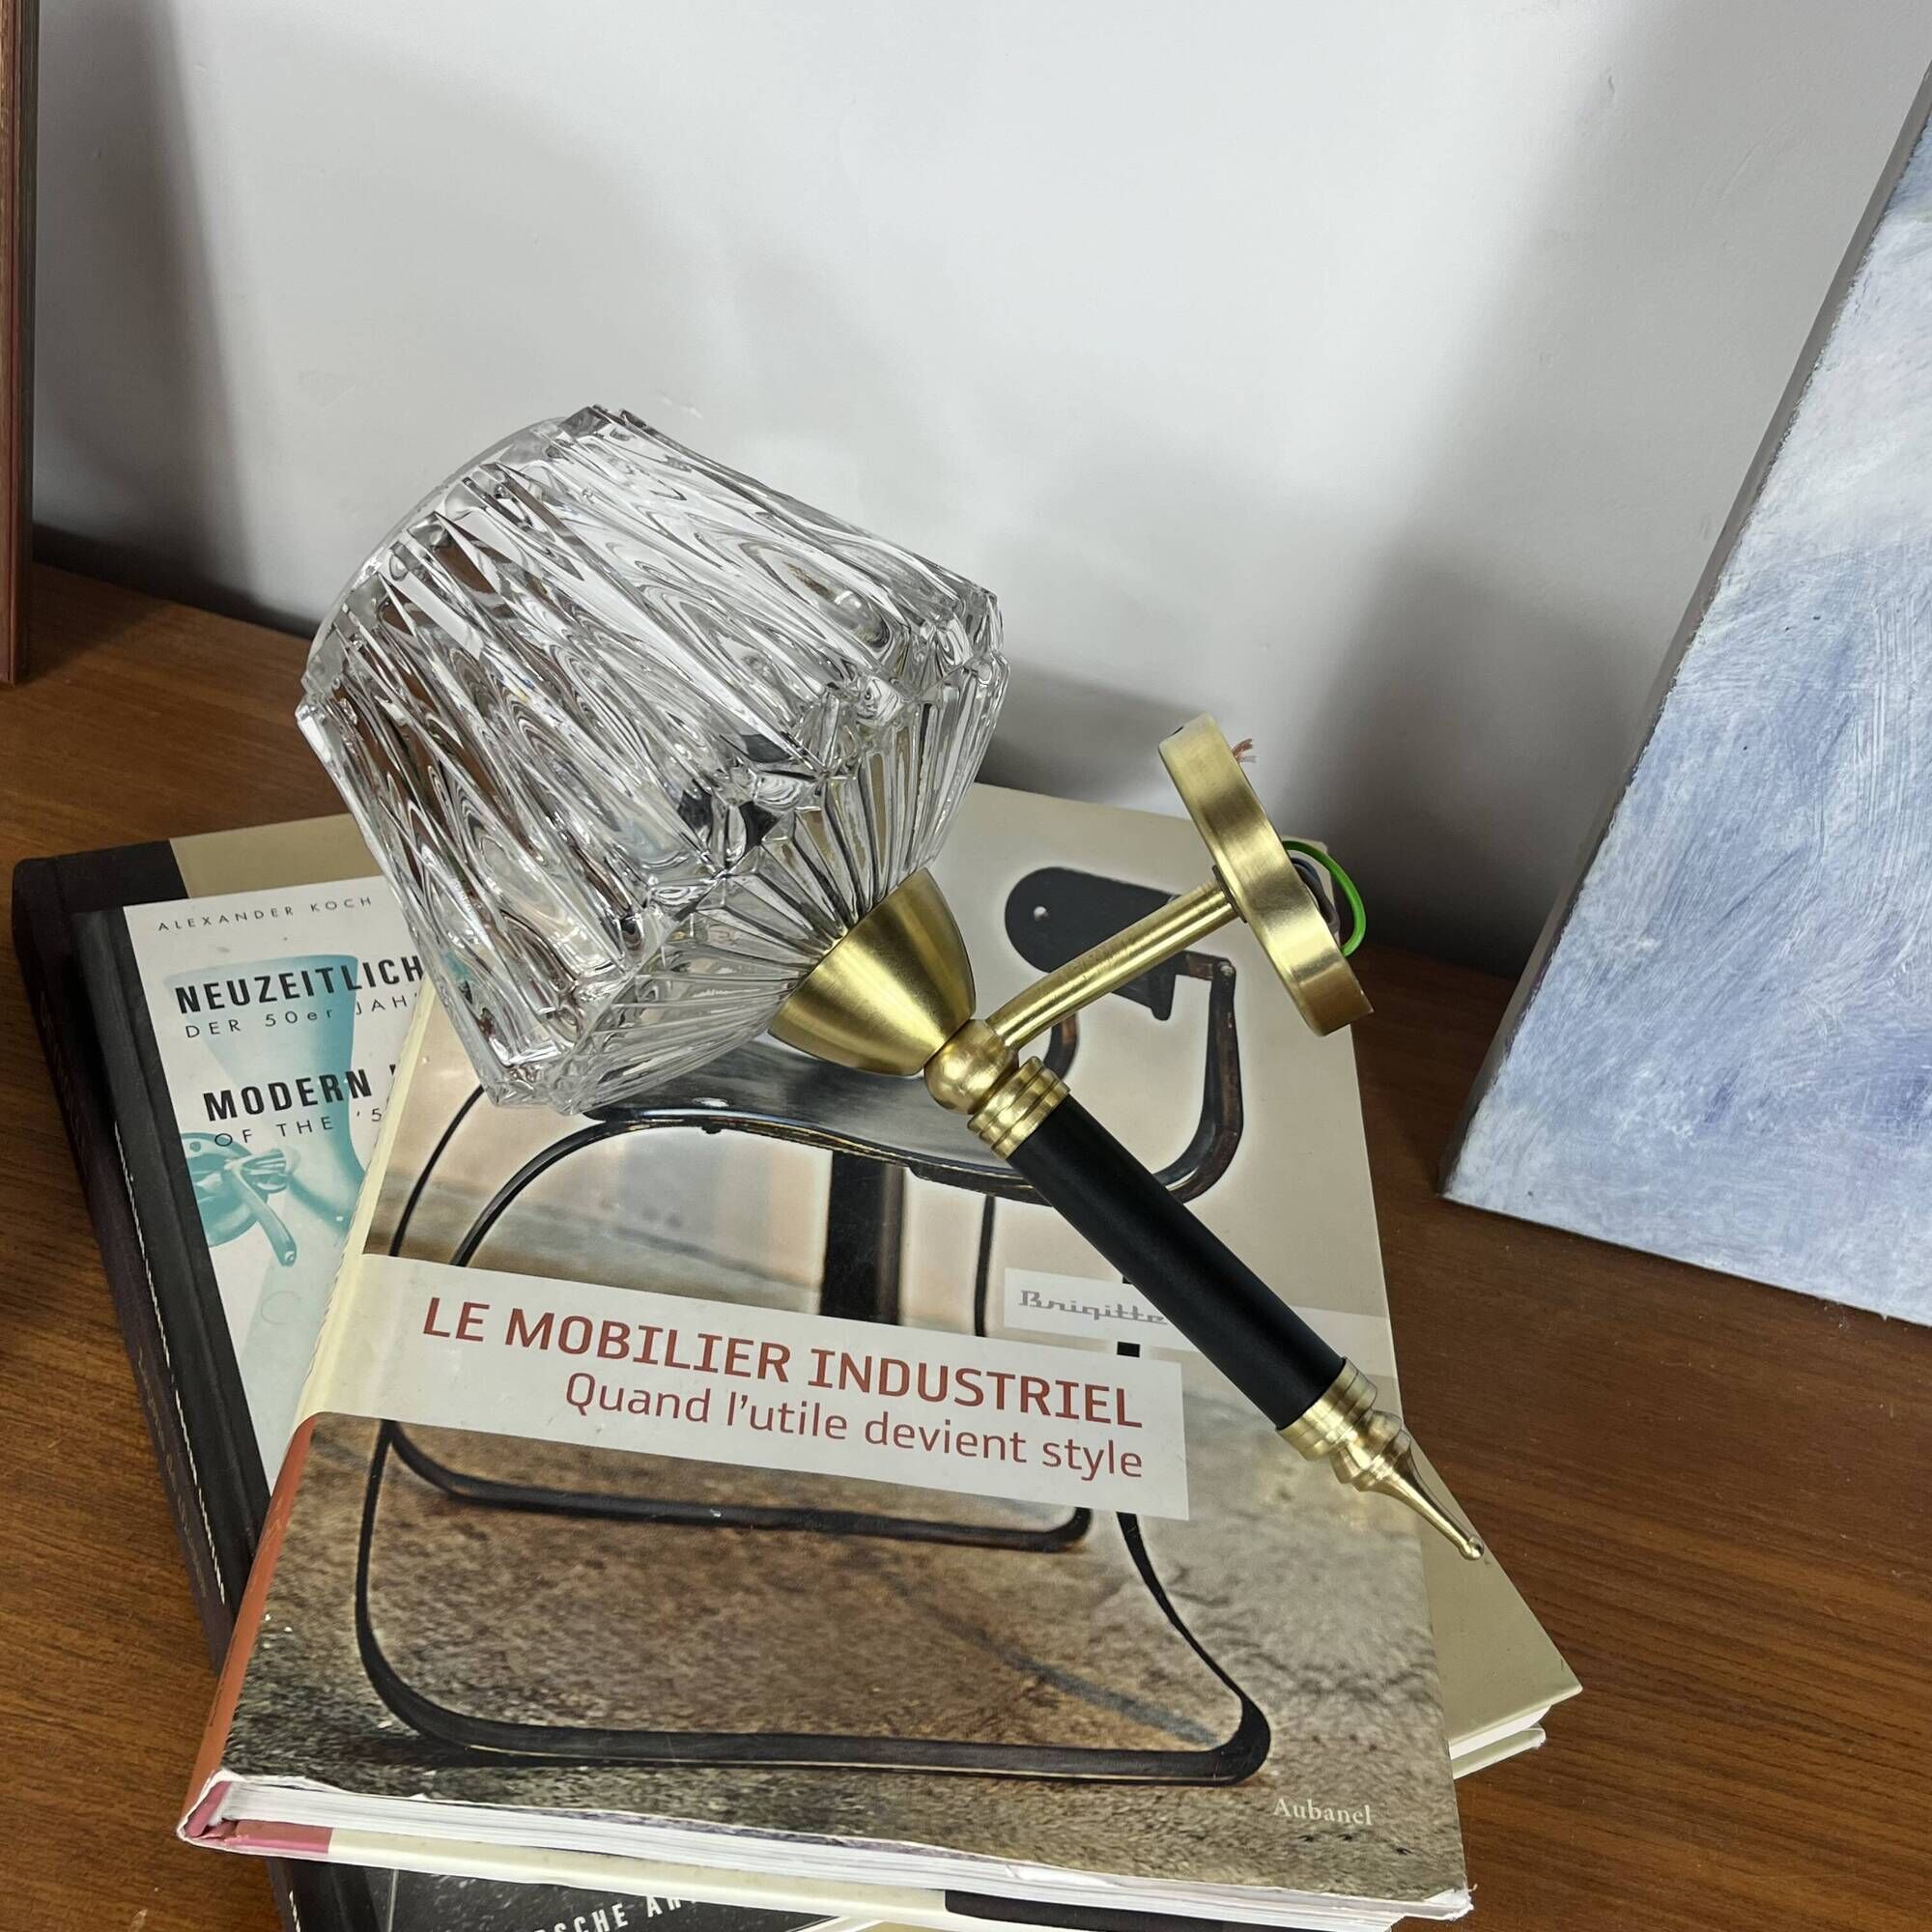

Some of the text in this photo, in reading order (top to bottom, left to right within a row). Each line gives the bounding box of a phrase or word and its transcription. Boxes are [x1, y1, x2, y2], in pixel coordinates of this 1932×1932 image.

[158, 895, 372, 931] ALEXANDER KOCH
[185, 1019, 242, 1038] DER
[265, 1009, 333, 1028] 50er
[203, 1068, 373, 1122] MODERN
[214, 1128, 253, 1147] OF
[276, 1116, 335, 1137] THE
[1018, 1290, 1168, 1325] Brigitte
[422, 1296, 1144, 1428] LE MOBILIER INDUSTRIEL
[565, 1372, 1144, 1482] Quand l'utile devient style
[1273, 1798, 1373, 1826] Aubanel
